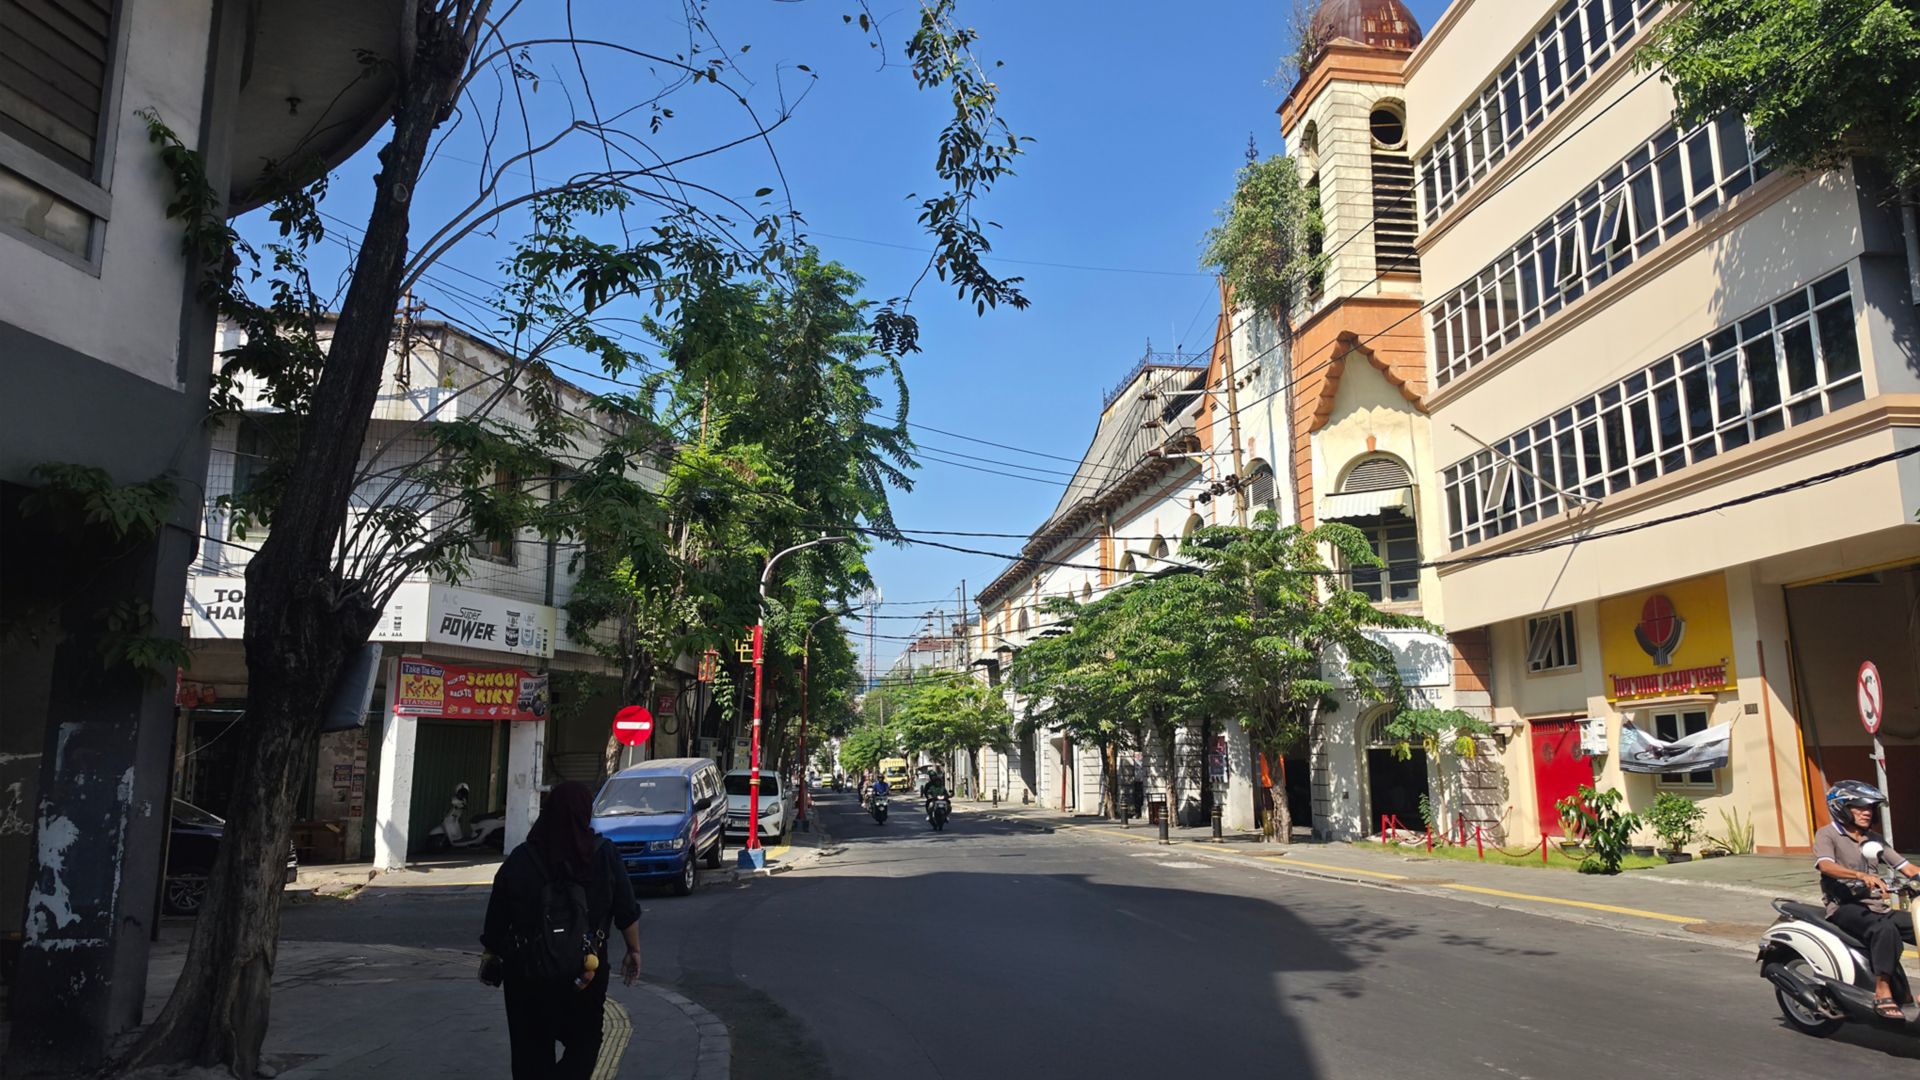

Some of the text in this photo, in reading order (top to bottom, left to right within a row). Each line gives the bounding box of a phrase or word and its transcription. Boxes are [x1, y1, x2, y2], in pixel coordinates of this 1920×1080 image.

[214, 589, 244, 603] TO
[445, 607, 482, 620] Super
[440, 616, 499, 643] POWER
[474, 688, 514, 705] KIKY
[1406, 688, 1442, 700] RAVEL
